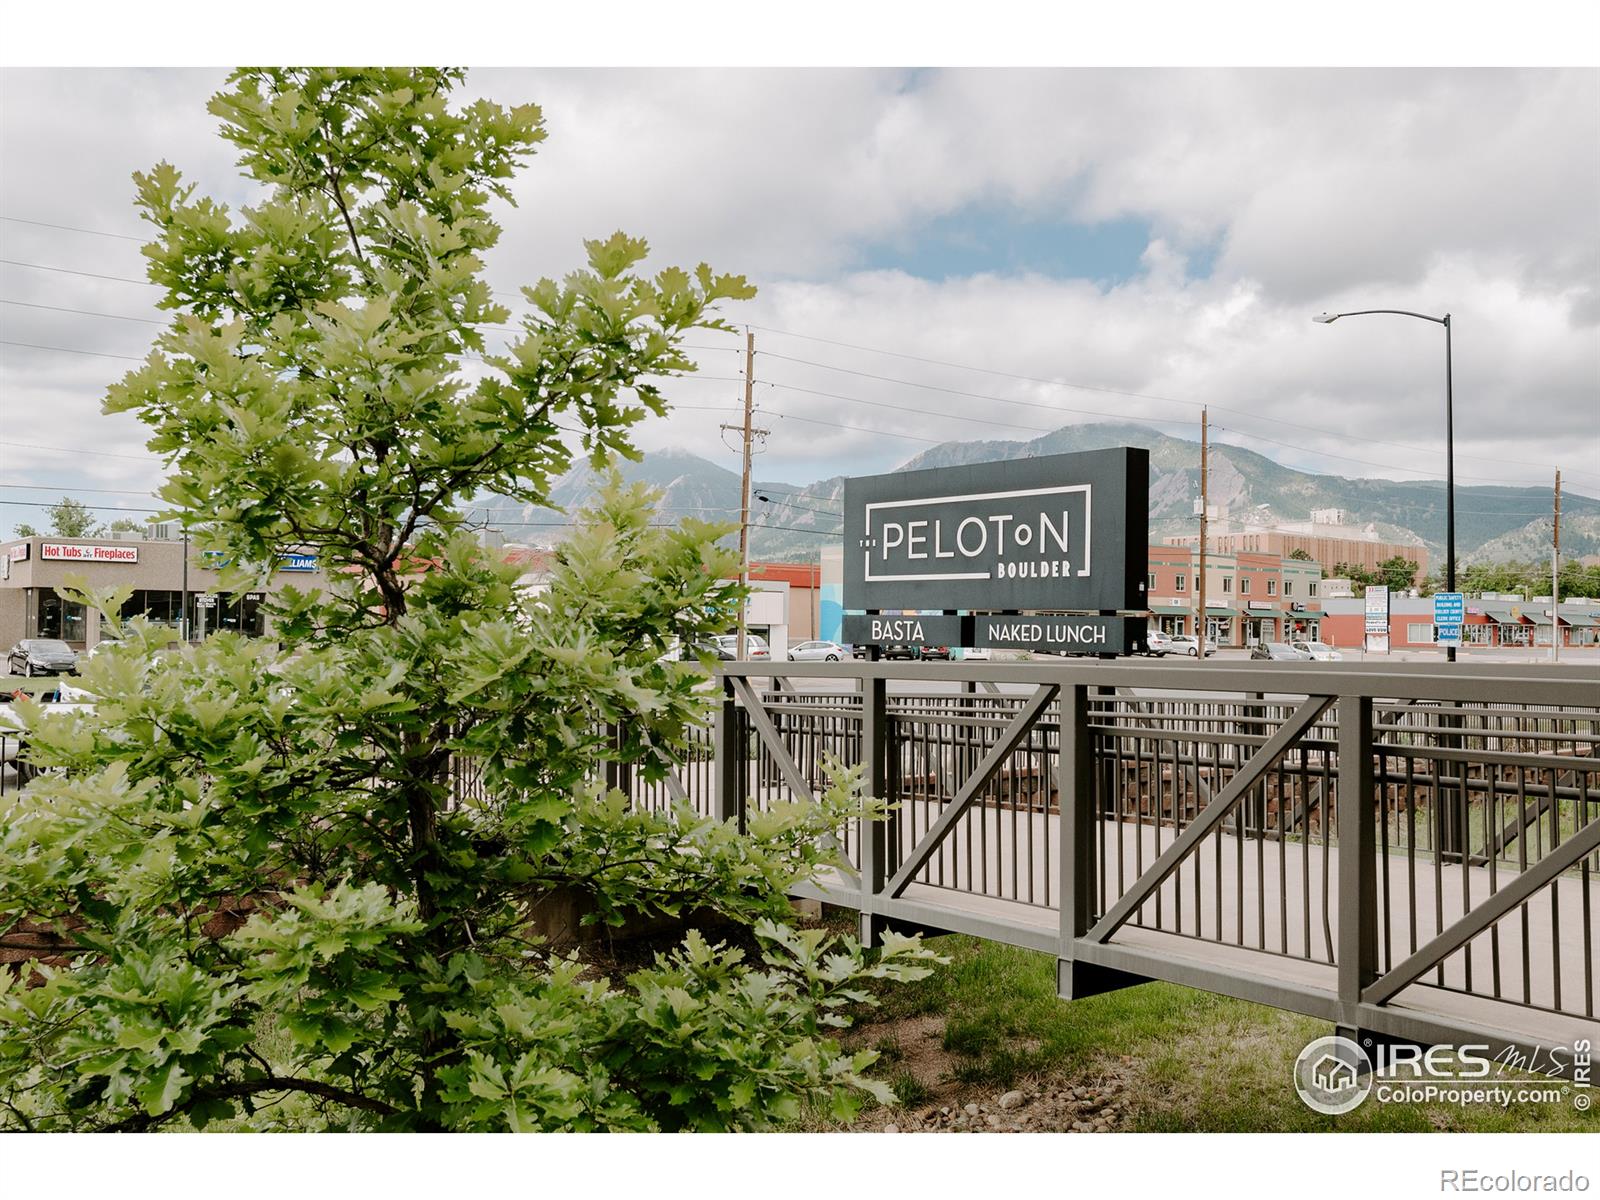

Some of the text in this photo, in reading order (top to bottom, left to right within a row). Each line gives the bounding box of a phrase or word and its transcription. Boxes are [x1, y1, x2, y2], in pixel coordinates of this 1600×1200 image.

[882, 510, 1069, 560] PELOTON
[44, 546, 60, 556] Hot
[62, 547, 82, 557] Tubs
[94, 548, 135, 560] Fireplaces
[288, 559, 317, 568] LIAMS
[998, 560, 1071, 579] BOULDER
[871, 620, 925, 641] BASTA
[988, 624, 1106, 644] NAKED LUNCH
[1439, 628, 1459, 636] POLICE
